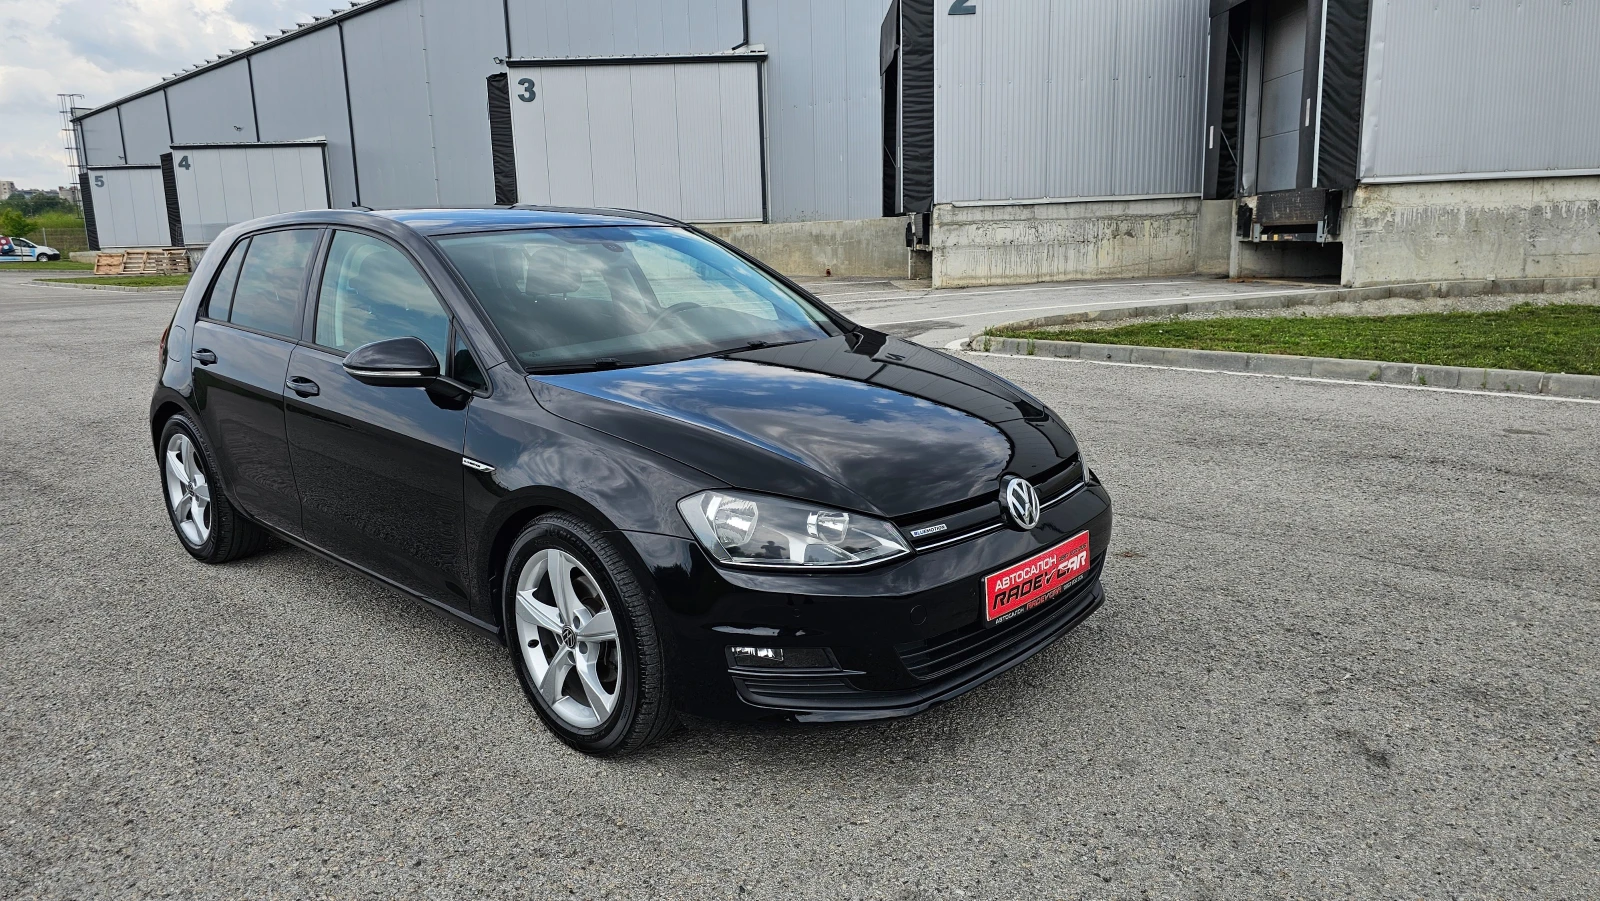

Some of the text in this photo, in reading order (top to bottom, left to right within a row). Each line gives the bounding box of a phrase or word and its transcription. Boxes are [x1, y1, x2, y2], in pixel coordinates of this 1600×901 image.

[517, 77, 536, 102] 3
[178, 155, 191, 170] 4
[94, 175, 105, 188] 5
[995, 554, 1057, 592] АВТОСАЛОН
